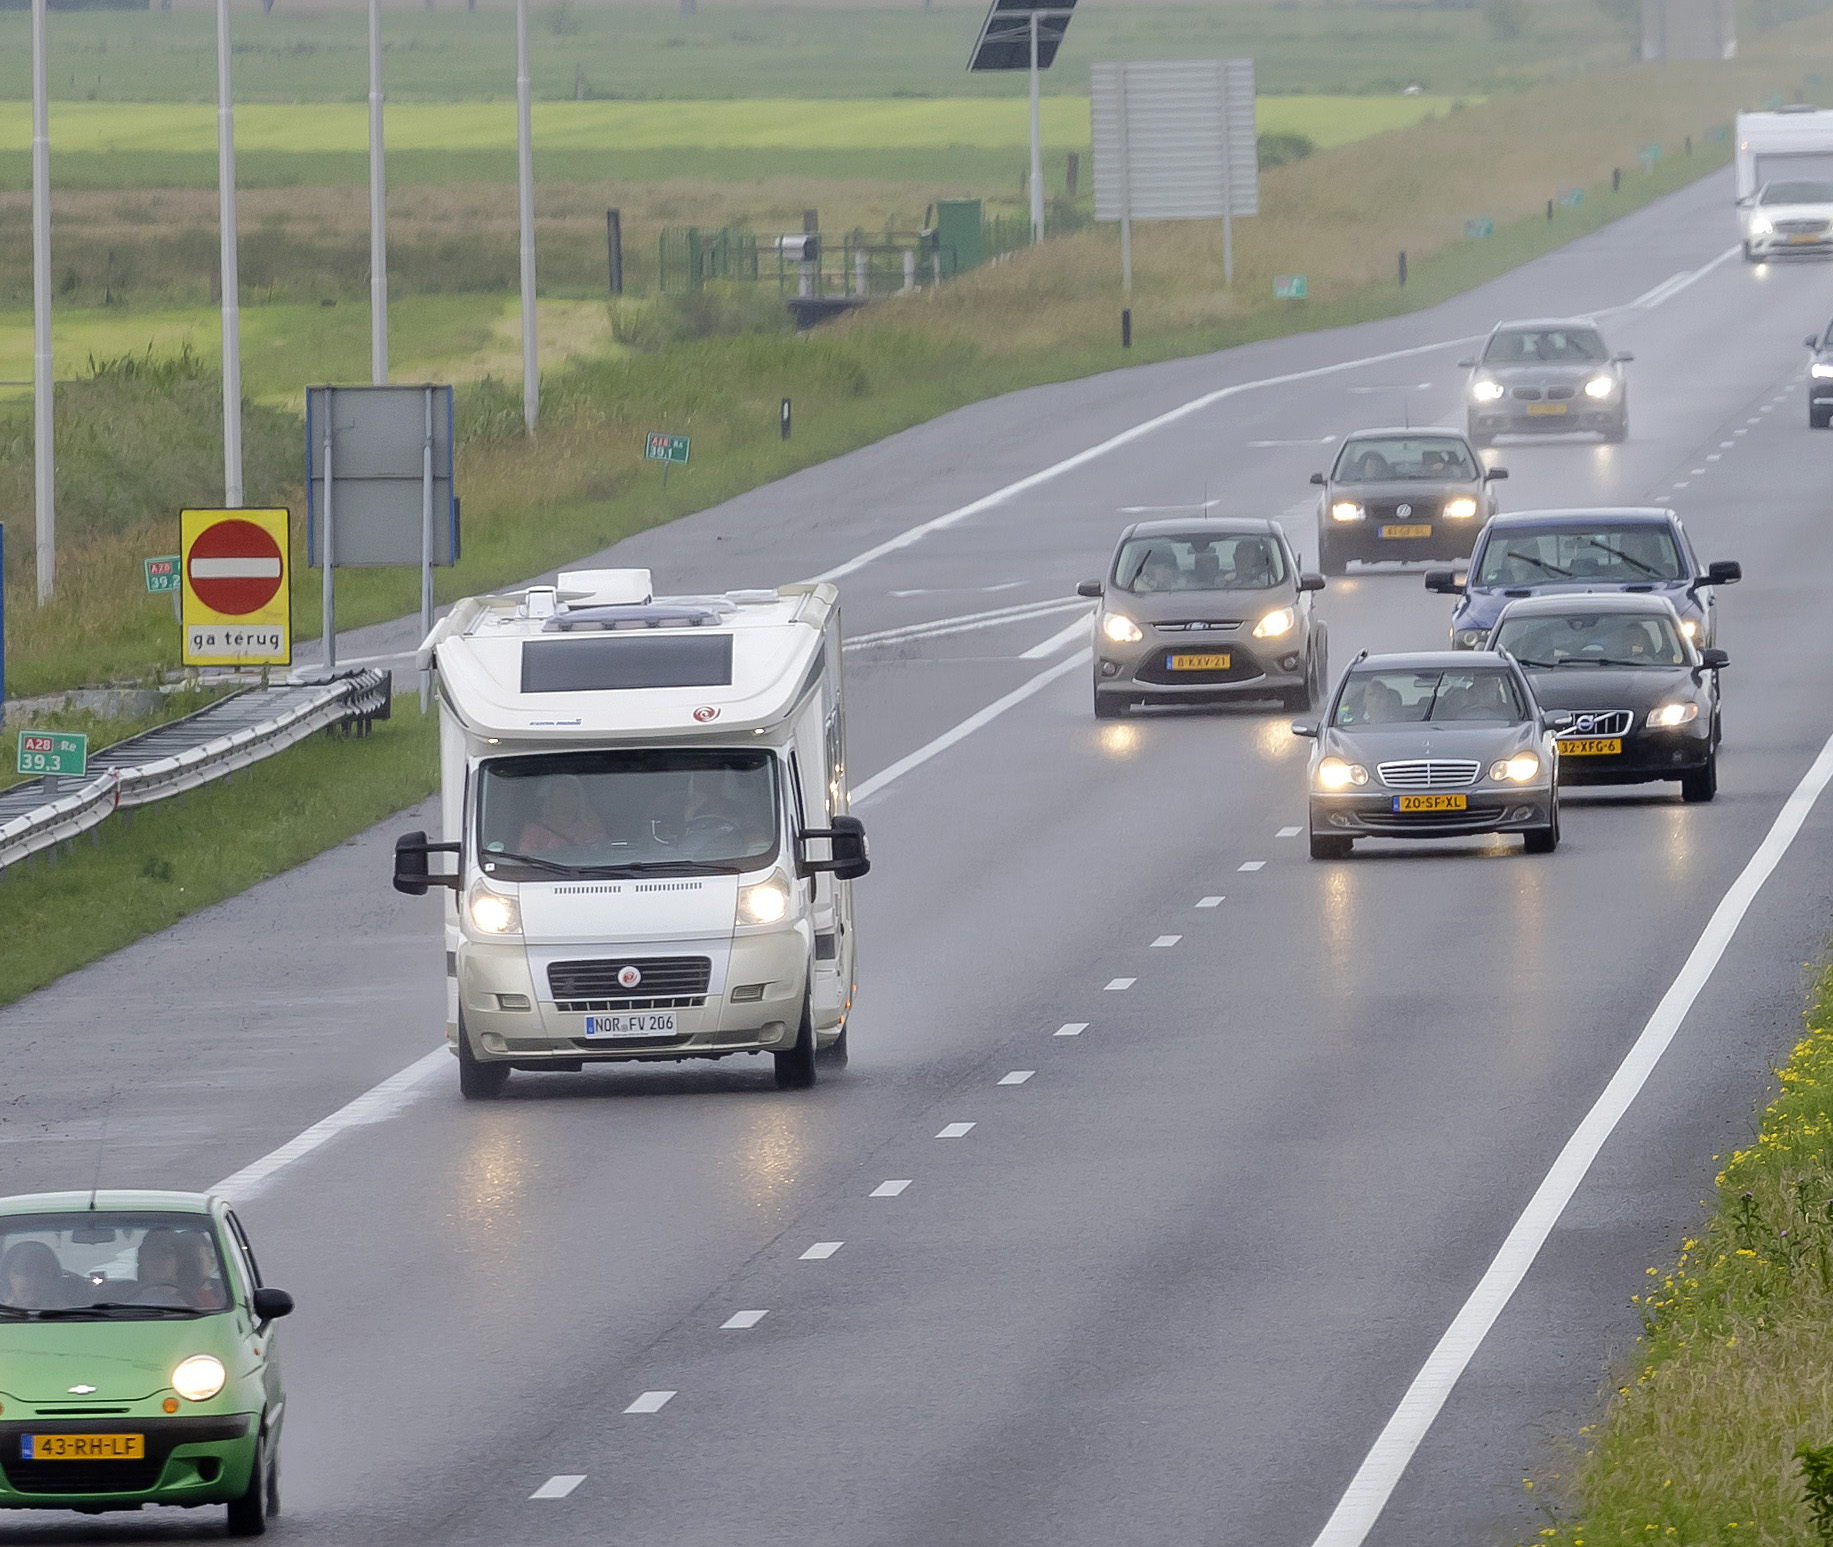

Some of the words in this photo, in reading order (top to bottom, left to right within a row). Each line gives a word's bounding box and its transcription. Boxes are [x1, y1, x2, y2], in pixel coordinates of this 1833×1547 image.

[193, 634, 216, 649] ga
[225, 631, 279, 649] terug
[26, 738, 51, 751] A28
[1561, 740, 1616, 754] 32-XFG-6
[1404, 795, 1462, 809] 20-SF-XL
[595, 1018, 620, 1032] NOR
[629, 1016, 646, 1031] FV
[649, 1015, 674, 1030] 206
[41, 1437, 136, 1455] 43-RH-LF
